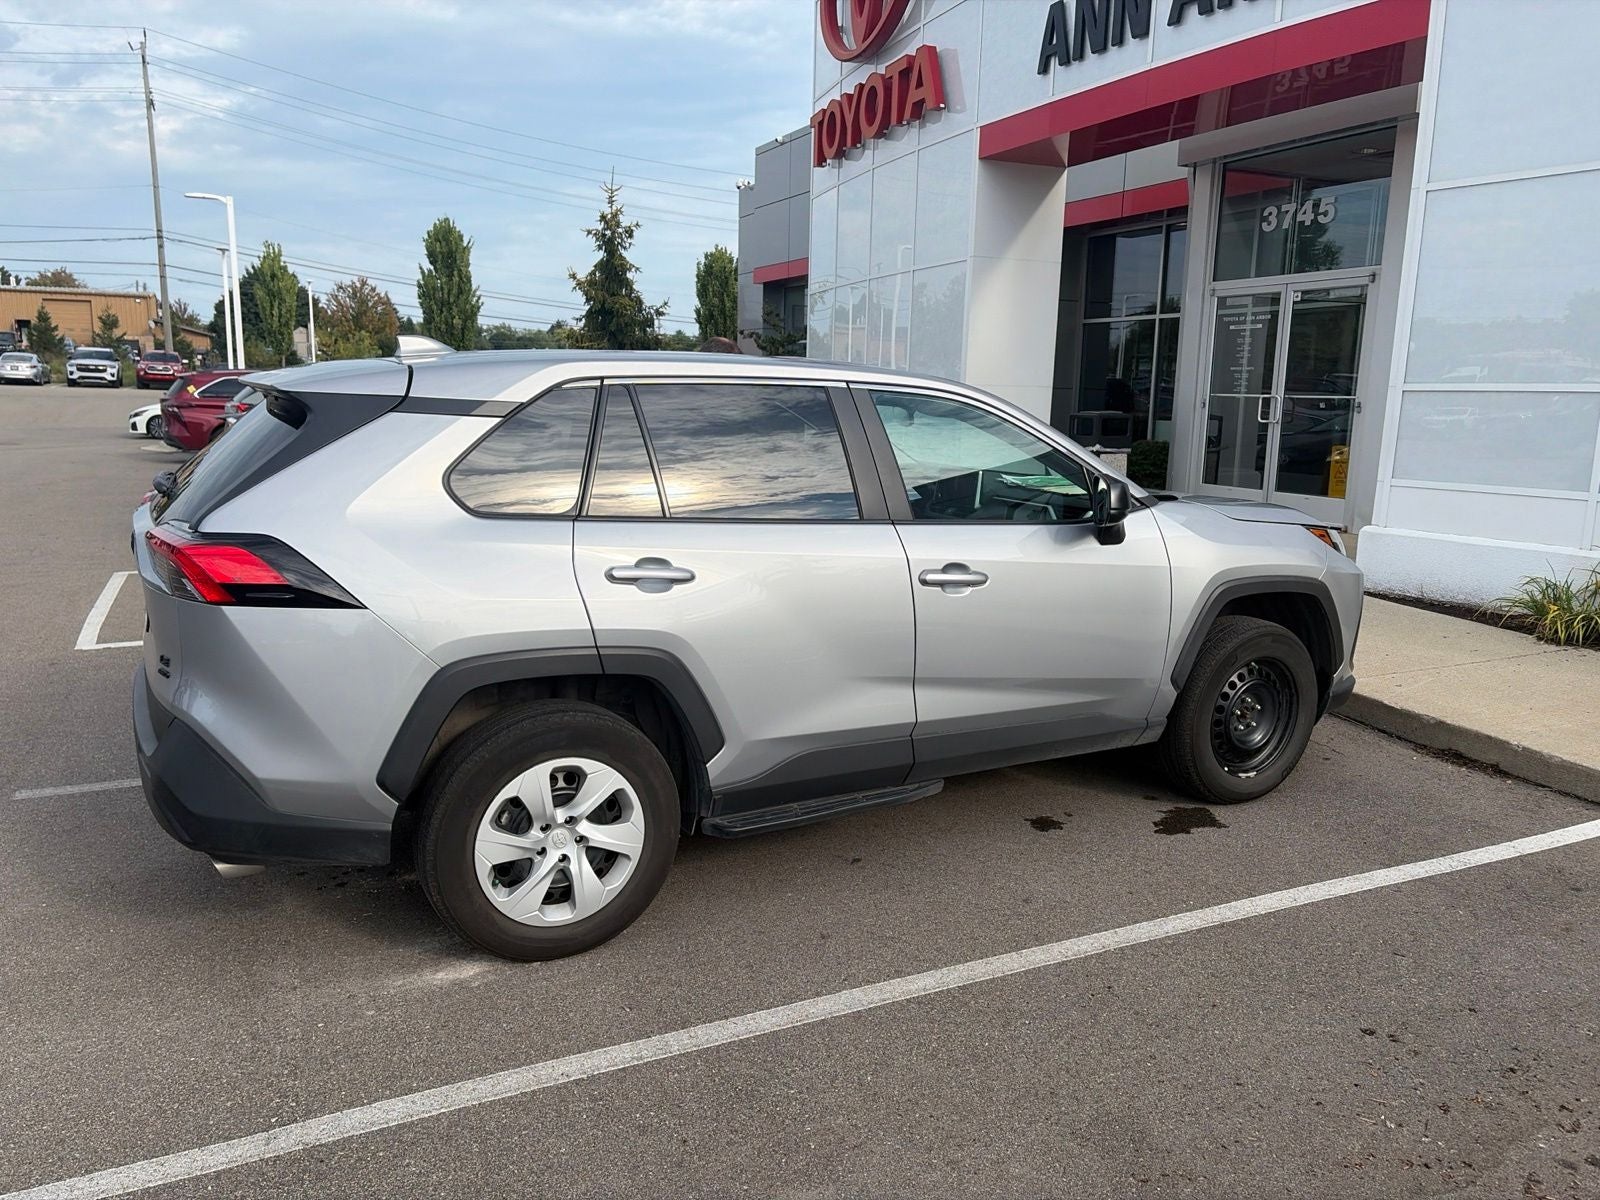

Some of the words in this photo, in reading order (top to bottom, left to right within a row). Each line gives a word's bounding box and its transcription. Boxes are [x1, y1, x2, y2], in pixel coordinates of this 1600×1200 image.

[1036, 0, 1151, 75] ANN
[809, 44, 945, 168] TOYOTA
[1261, 196, 1336, 232] 3745
